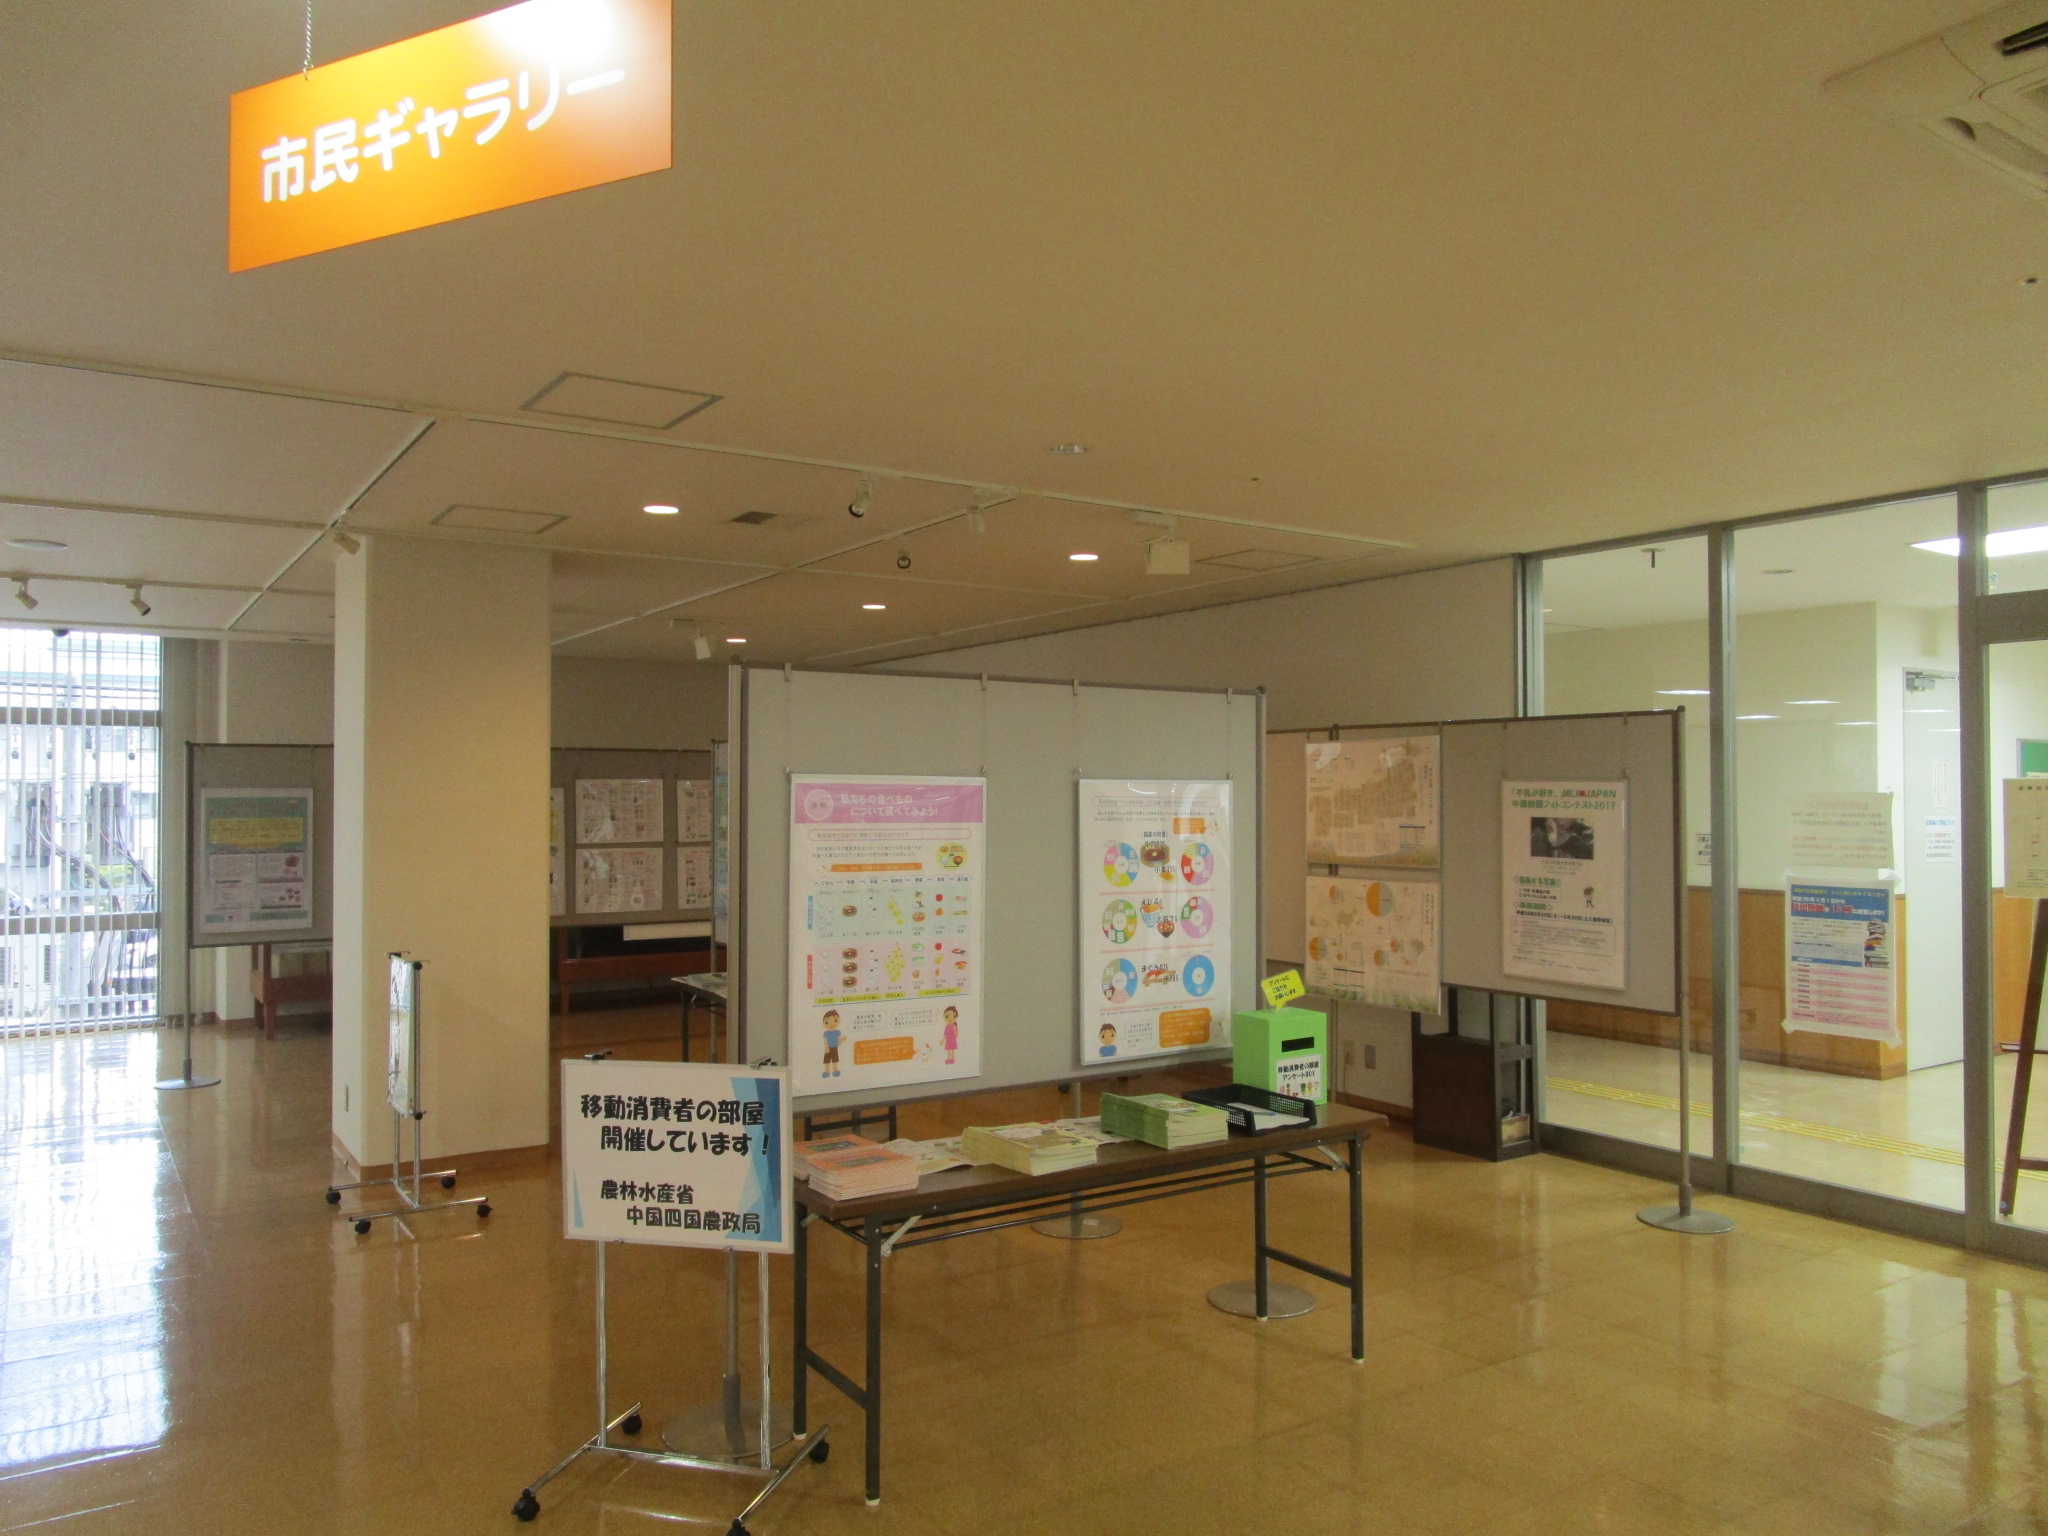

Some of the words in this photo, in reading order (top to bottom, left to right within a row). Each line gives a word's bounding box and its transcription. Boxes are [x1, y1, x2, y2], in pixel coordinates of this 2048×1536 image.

[262, 63, 625, 203] 市民ギャラリー
[1283, 1070, 1315, 1081] アンケートBOX
[580, 1094, 765, 1126] 移動消費者の部屋
[600, 1126, 769, 1156] 開催しています！
[600, 1179, 695, 1205] 農林水産省
[626, 1206, 761, 1234] 中国四国農政局
